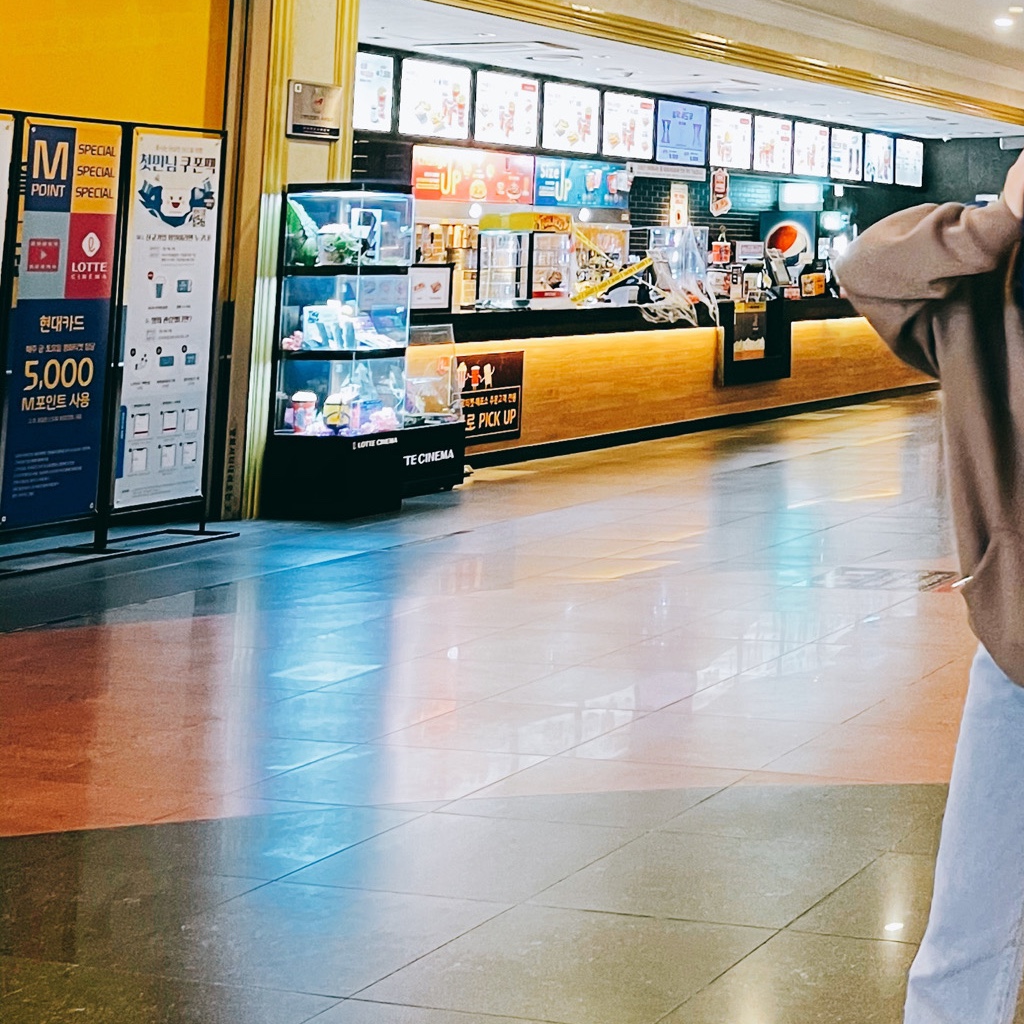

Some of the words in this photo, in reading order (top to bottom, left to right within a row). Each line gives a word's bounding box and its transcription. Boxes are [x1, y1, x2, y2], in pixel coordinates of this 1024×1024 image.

[78, 144, 116, 157] SPECIAL
[32, 140, 69, 180] M
[77, 166, 115, 178] SPECIAL
[31, 184, 66, 198] POINT
[76, 187, 114, 199] SPECIAL
[71, 262, 107, 273] LOTTE
[39, 315, 85, 333] 현대카드
[23, 357, 94, 391] 5,000
[21, 394, 67, 411] M포인트
[69, 392, 91, 408] 사용
[478, 410, 501, 429] PICK
[503, 408, 517, 425] UP
[417, 448, 455, 464] CINEMA
